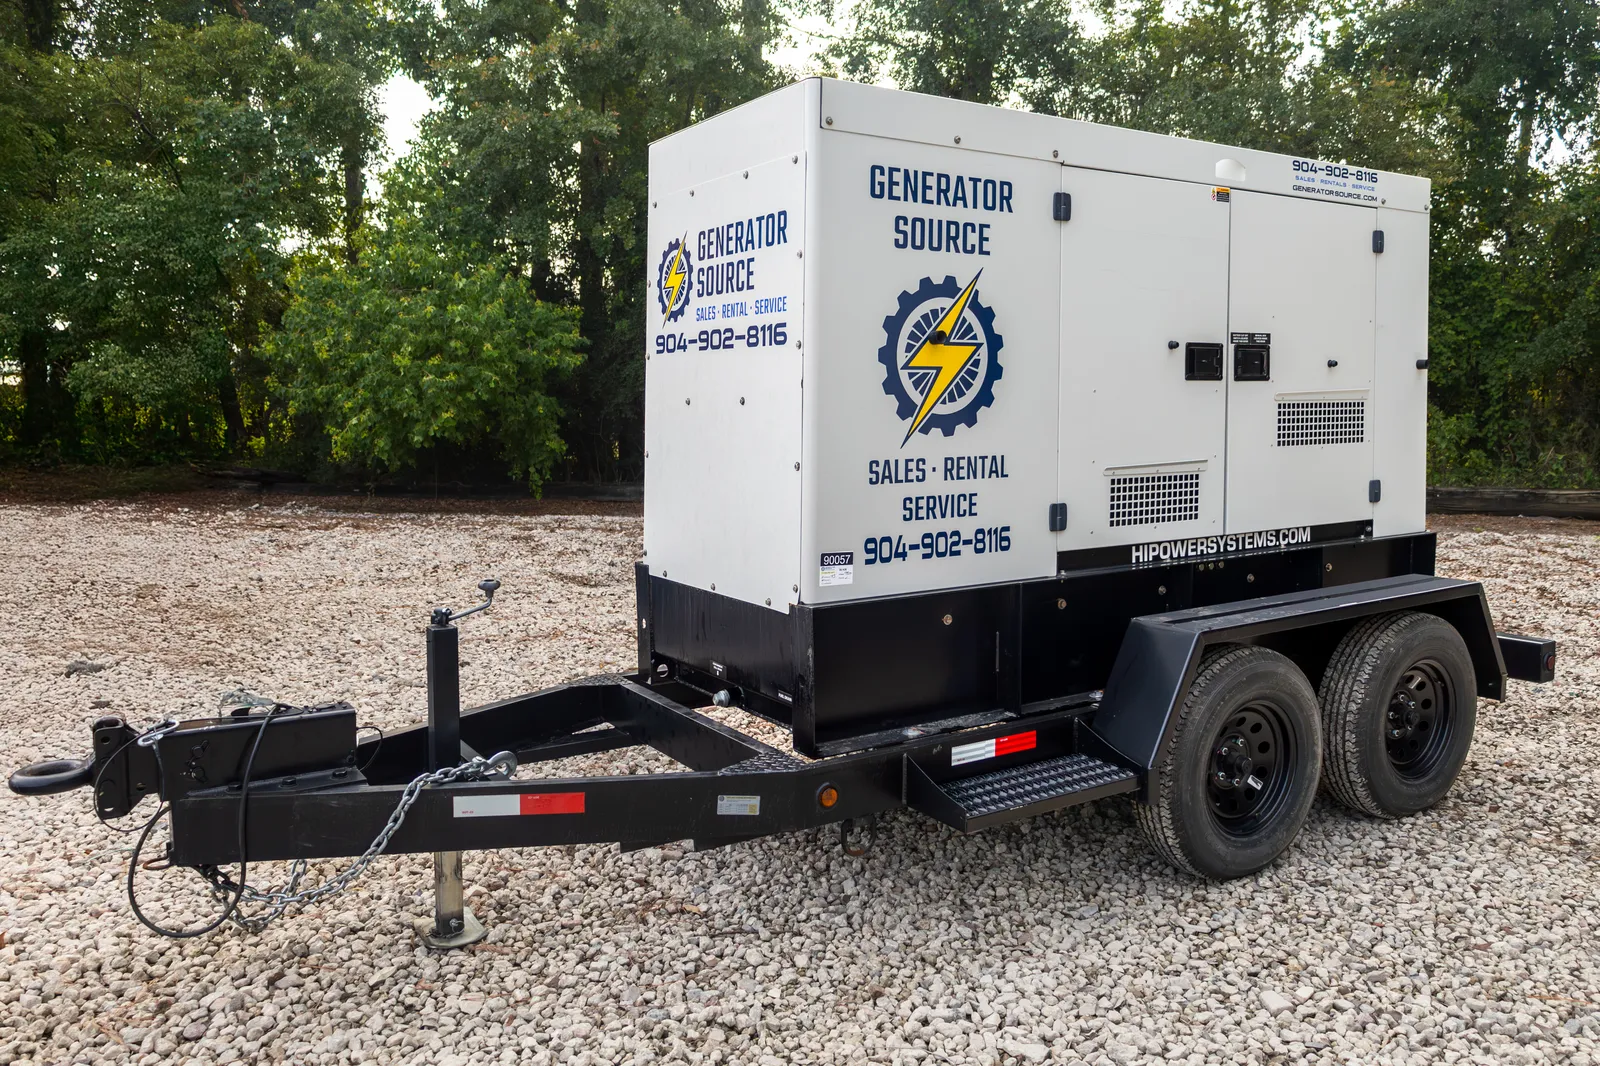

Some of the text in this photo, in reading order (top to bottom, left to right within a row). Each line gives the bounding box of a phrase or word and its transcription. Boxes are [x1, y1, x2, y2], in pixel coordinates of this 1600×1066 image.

[1293, 160, 1378, 183] 904-902-8116
[1295, 175, 1375, 192] SALES RENTALS SERVICE
[870, 164, 1013, 213] GENERATOR
[1292, 184, 1378, 202] GENERATORSOURCE.COM
[698, 210, 788, 261] GENERATOR
[894, 215, 991, 256] SOURCE
[697, 257, 755, 298] SOURCE
[696, 296, 788, 322] SALES RENTAL SERVICE
[656, 322, 788, 355] 904-902-8116
[868, 455, 1009, 485] SALES RENTAL
[902, 493, 978, 522] SERVICE
[823, 554, 851, 566] 90057
[864, 525, 1011, 565] 904-902-8116
[1131, 526, 1312, 563] HIPOWERSYSTEMS.COM
